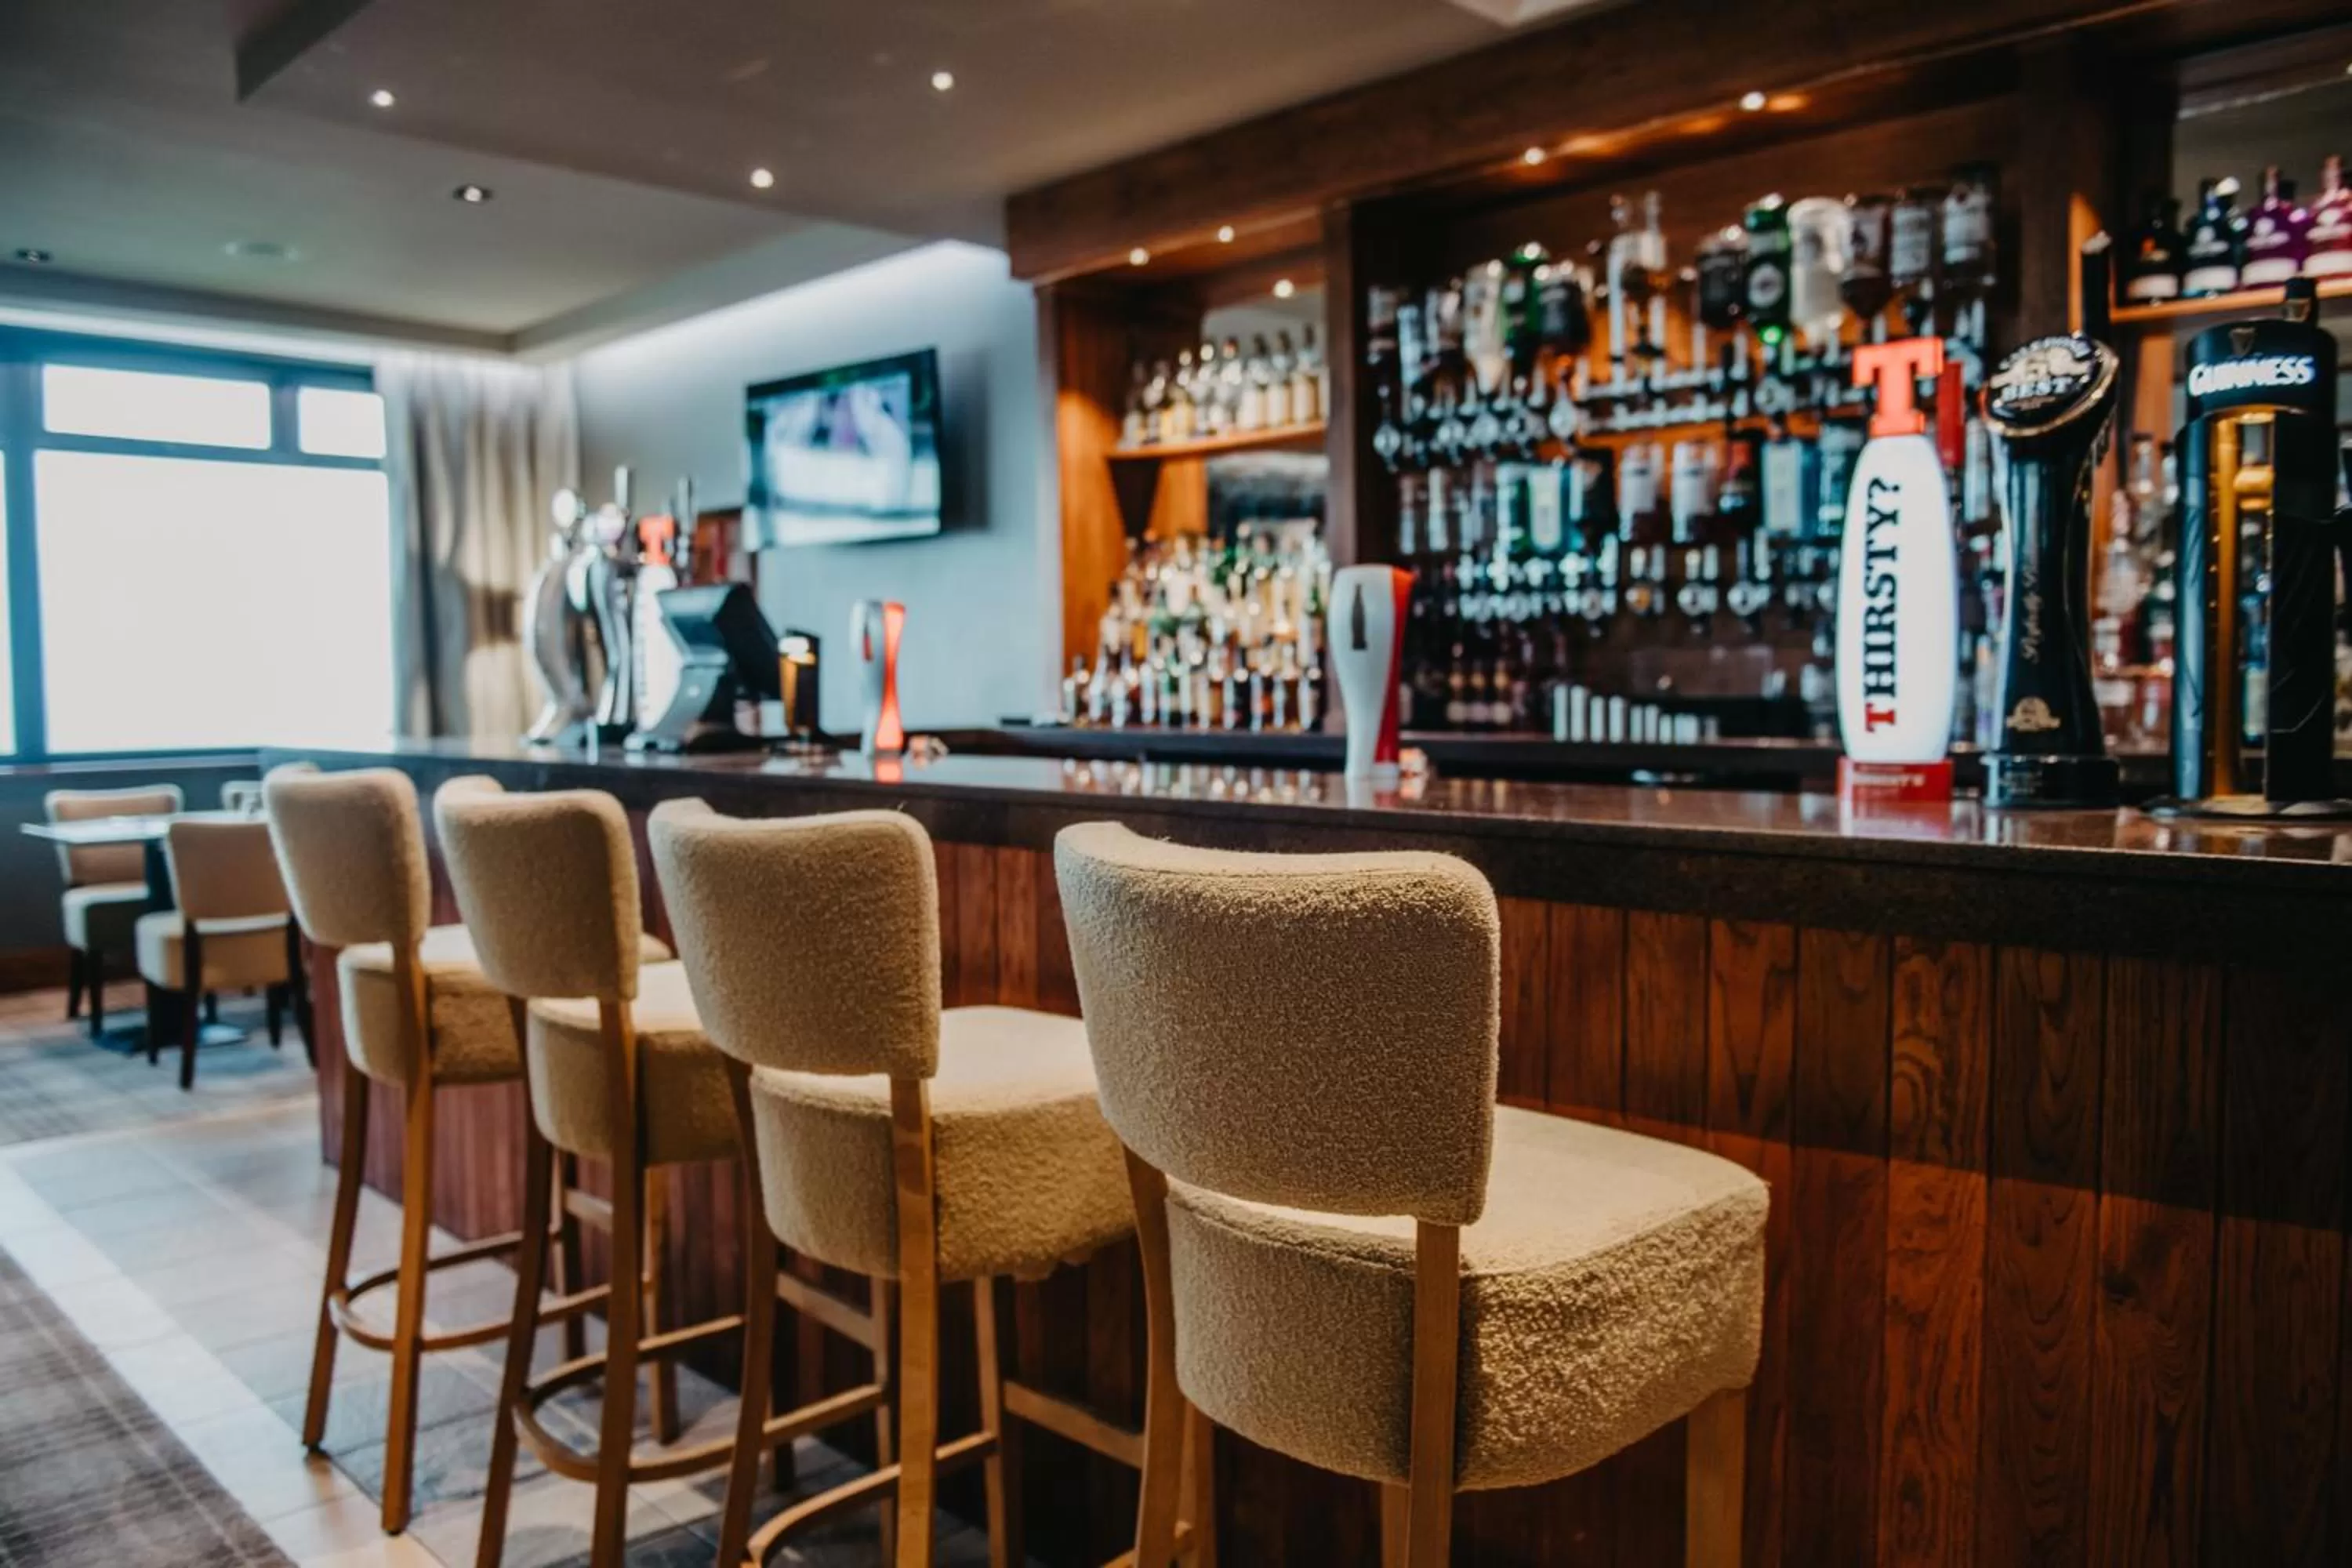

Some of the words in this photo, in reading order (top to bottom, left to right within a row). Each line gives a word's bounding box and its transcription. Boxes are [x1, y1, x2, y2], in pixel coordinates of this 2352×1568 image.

[1852, 336, 1943, 437] T
[2000, 376, 2074, 402] BEST
[2188, 355, 2315, 397] GUINNESS
[1864, 476, 1901, 734] THIRSTY?
